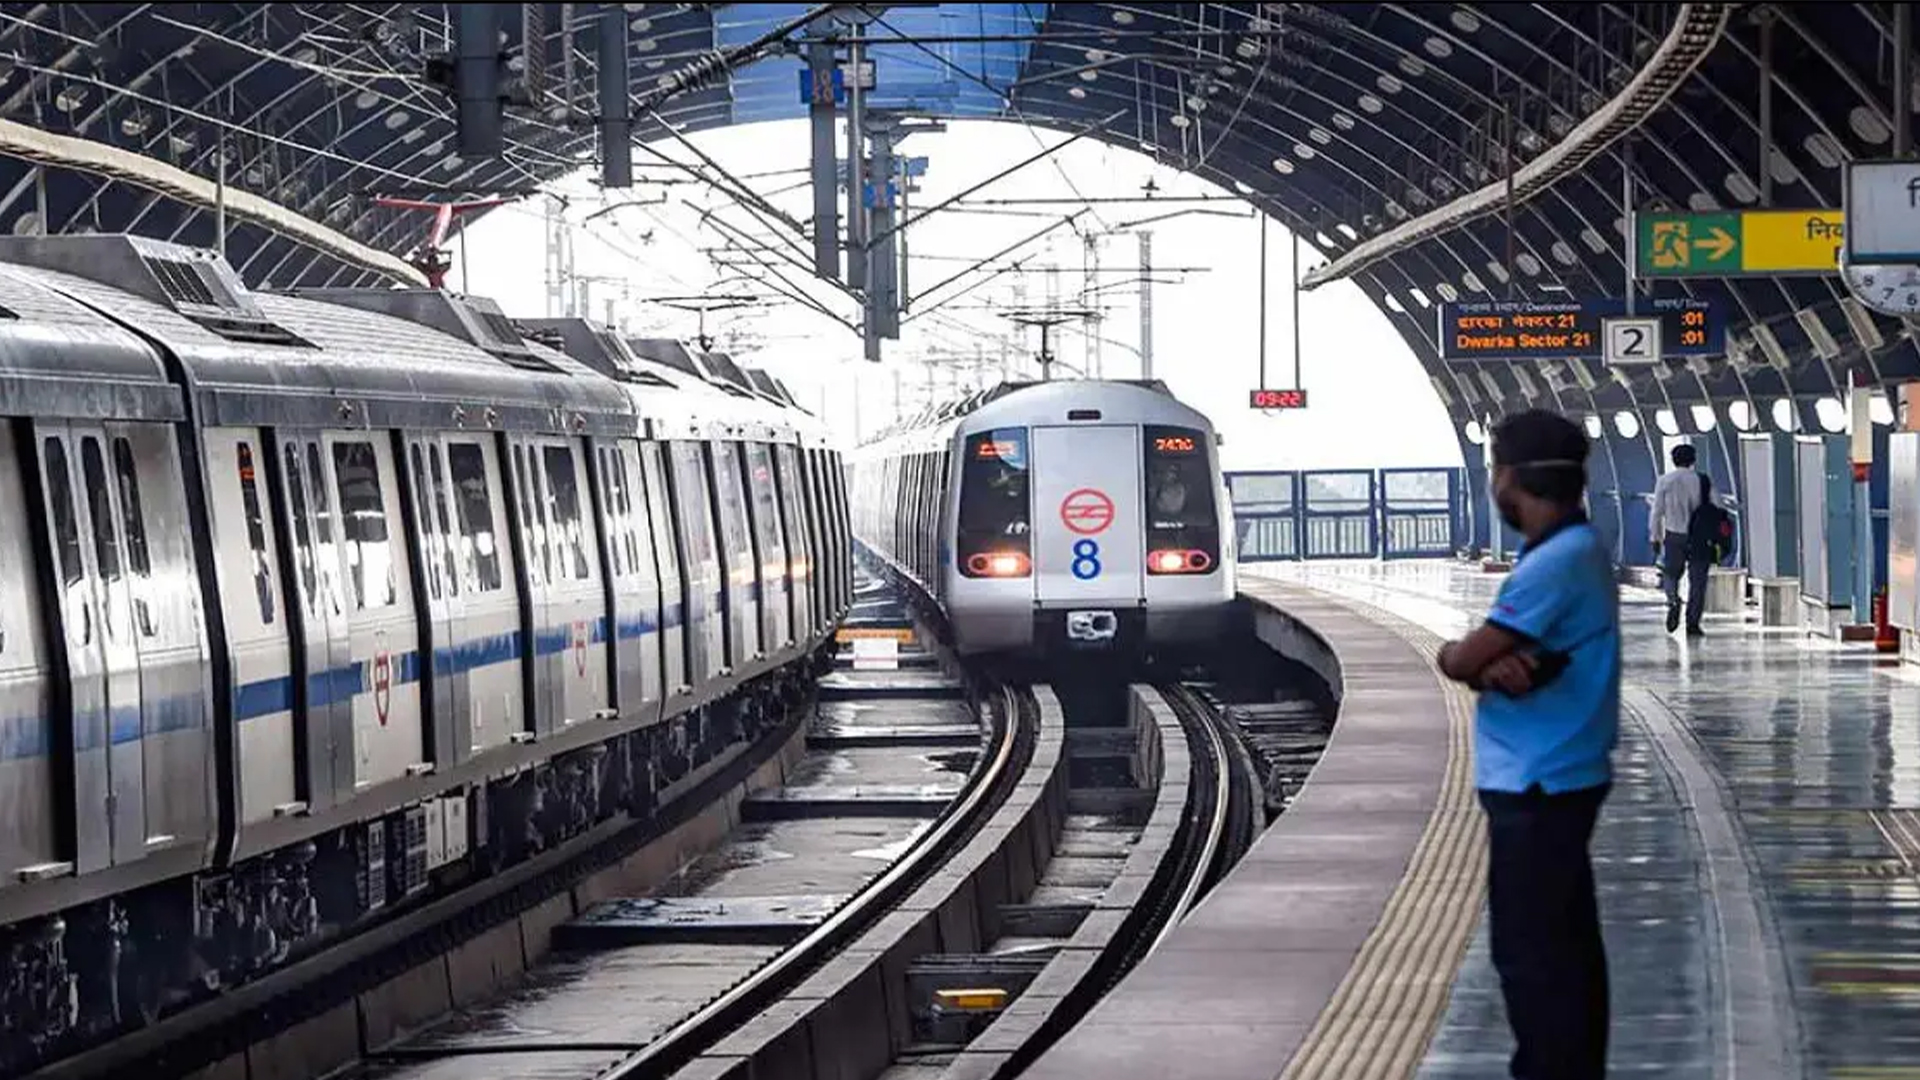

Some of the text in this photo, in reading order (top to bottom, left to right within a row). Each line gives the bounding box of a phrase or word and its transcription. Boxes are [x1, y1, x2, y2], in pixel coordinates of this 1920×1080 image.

[1863, 275, 1874, 287] 8
[1883, 287, 1895, 300] 7
[1907, 293, 1917, 306] 6
[1558, 314, 1575, 328] 21
[1457, 331, 1590, 348] Dwarka Sector 21
[1623, 328, 1644, 355] 2
[1072, 539, 1101, 580] 8
